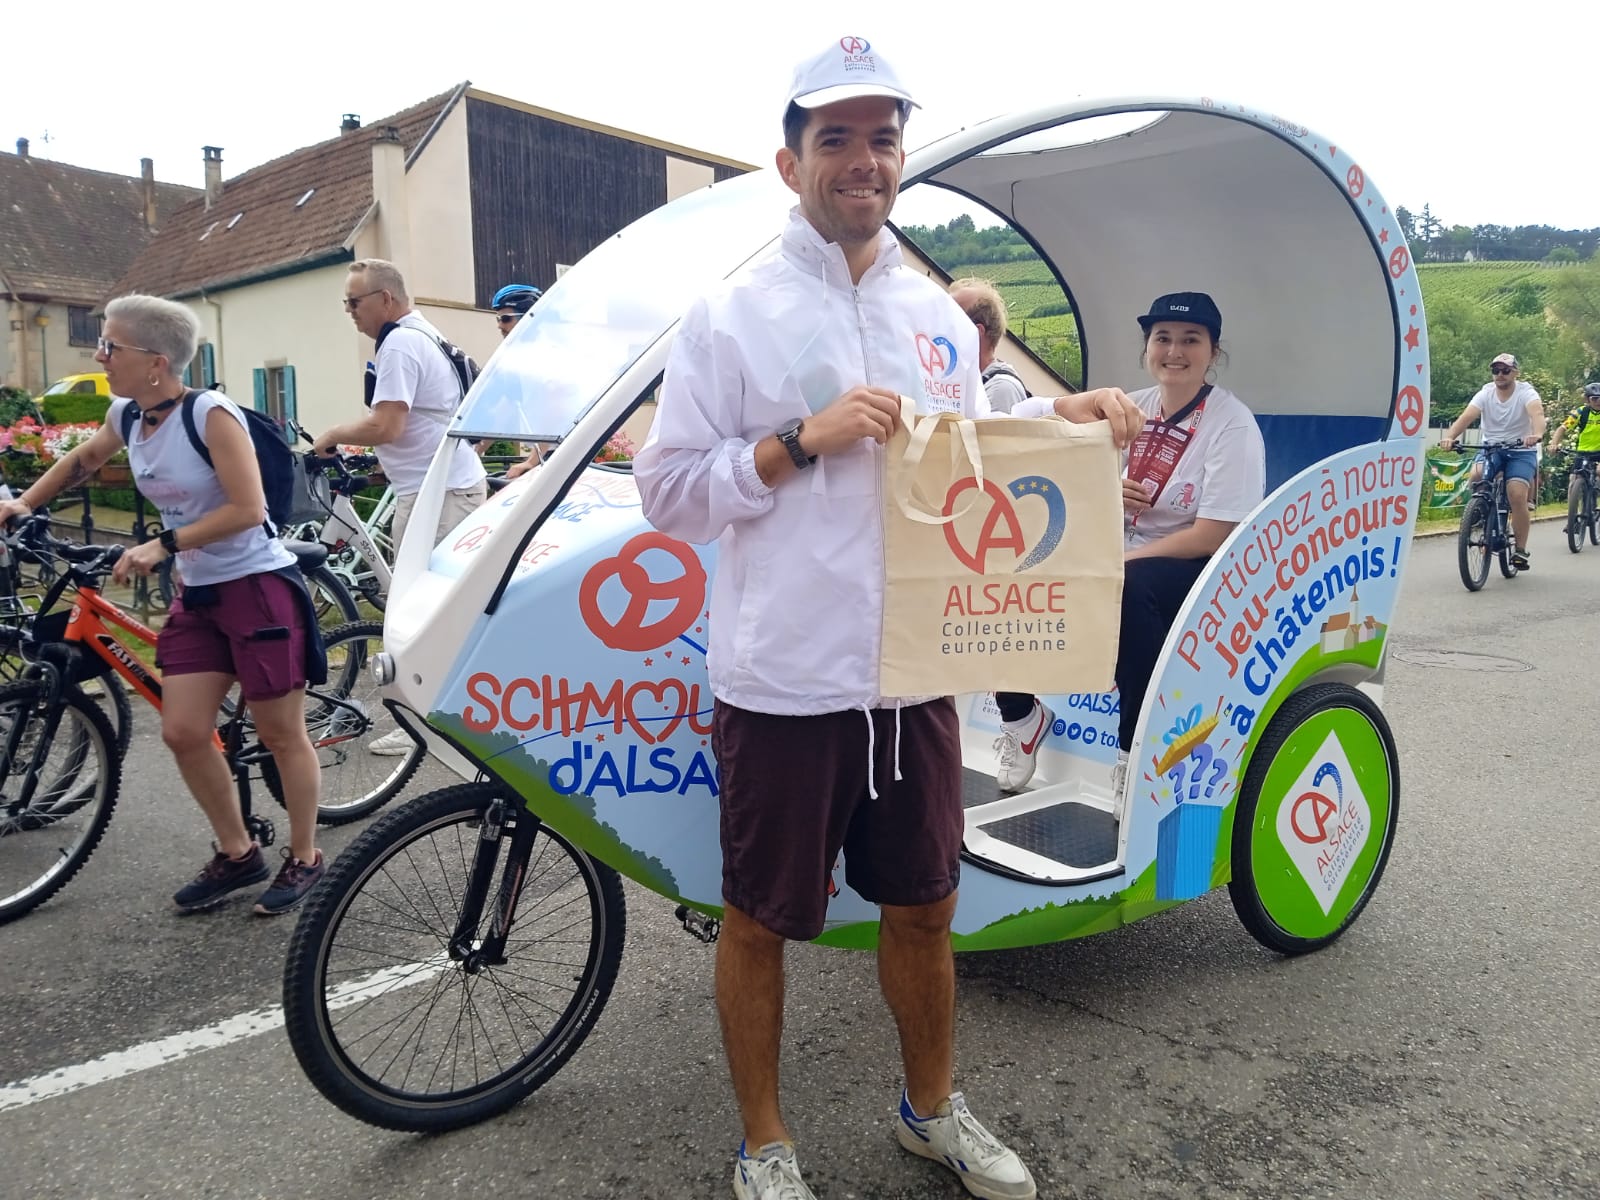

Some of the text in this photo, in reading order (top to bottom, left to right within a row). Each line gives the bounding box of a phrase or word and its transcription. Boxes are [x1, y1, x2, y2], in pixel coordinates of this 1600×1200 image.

[924, 378, 961, 399] ALSACE
[1177, 451, 1416, 672] Participez à notre
[943, 581, 1066, 617] ALSACE
[1214, 495, 1408, 680] Jeu-concours
[941, 618, 1066, 637] Collectivité
[941, 636, 1066, 655] européenne
[548, 740, 720, 799] d'ALSA
[1316, 800, 1358, 876] ALSACE
